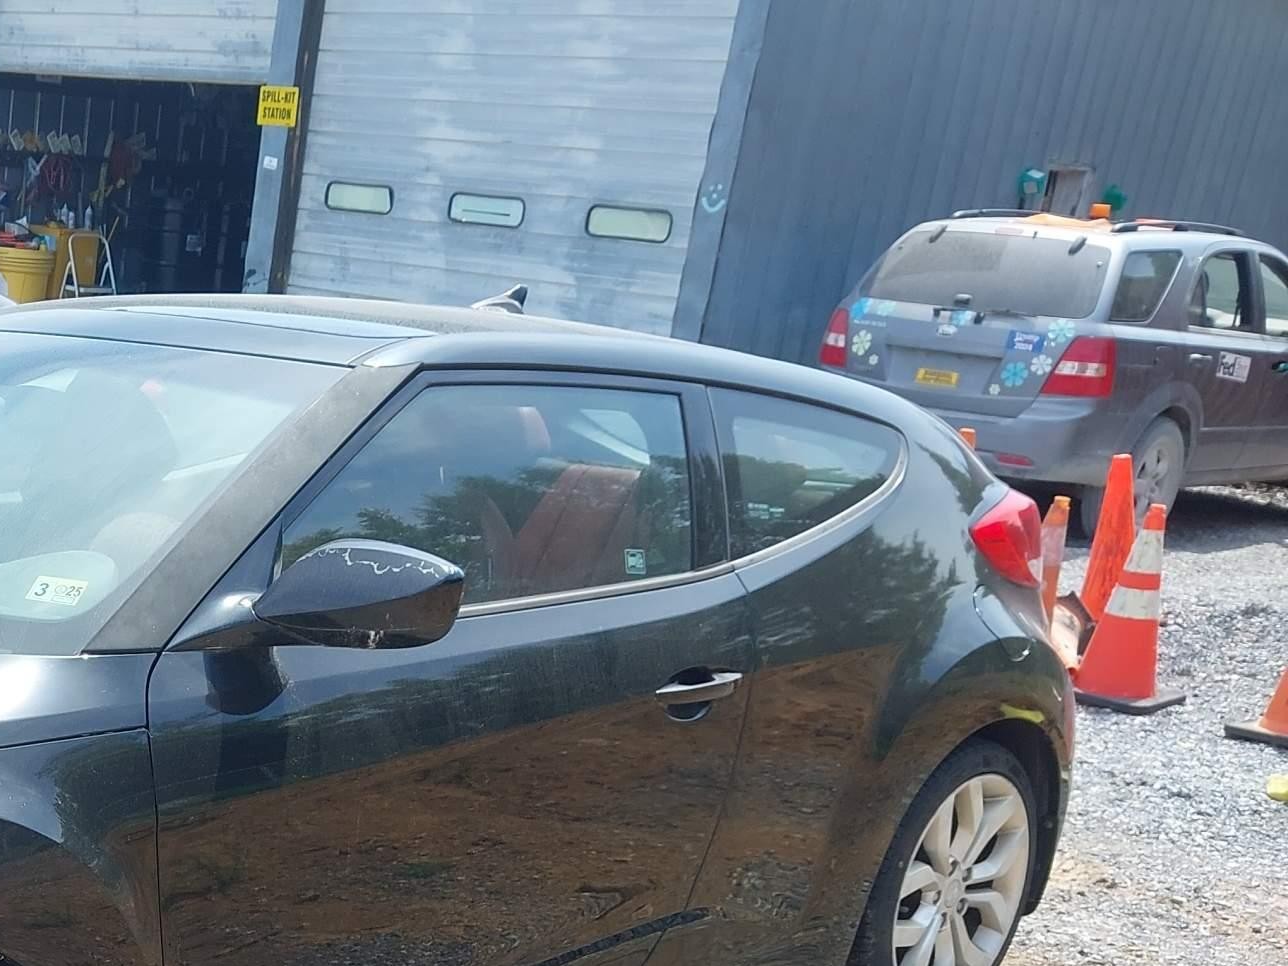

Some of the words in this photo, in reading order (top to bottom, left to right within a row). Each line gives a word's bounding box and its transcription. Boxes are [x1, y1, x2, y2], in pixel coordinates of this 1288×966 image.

[262, 90, 296, 104] SPILL-KIT
[263, 107, 292, 120] STATION
[34, 583, 49, 597] 3
[65, 586, 84, 598] 25
